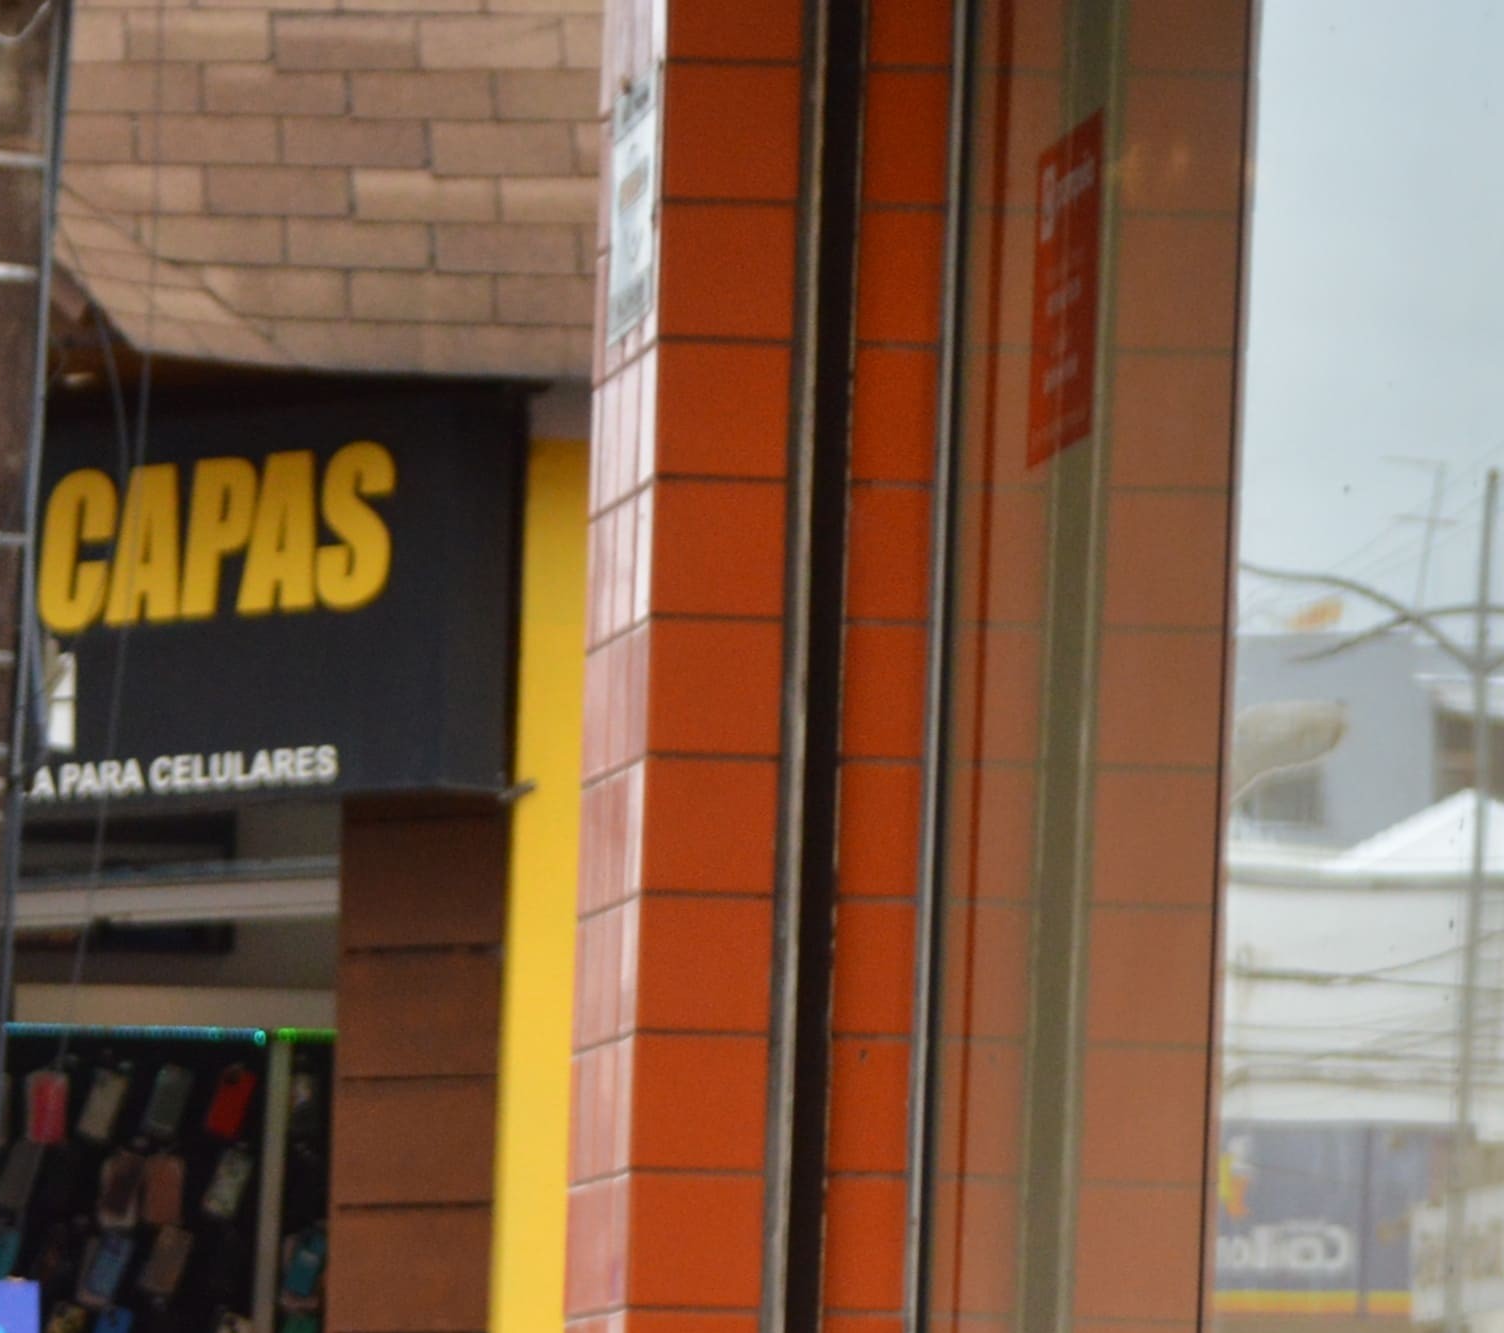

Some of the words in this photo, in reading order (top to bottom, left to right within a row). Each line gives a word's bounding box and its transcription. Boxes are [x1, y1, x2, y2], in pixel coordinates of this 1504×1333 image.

[37, 440, 397, 635] CAPAS
[58, 758, 145, 796] PARA
[148, 745, 337, 792] CELULARES
